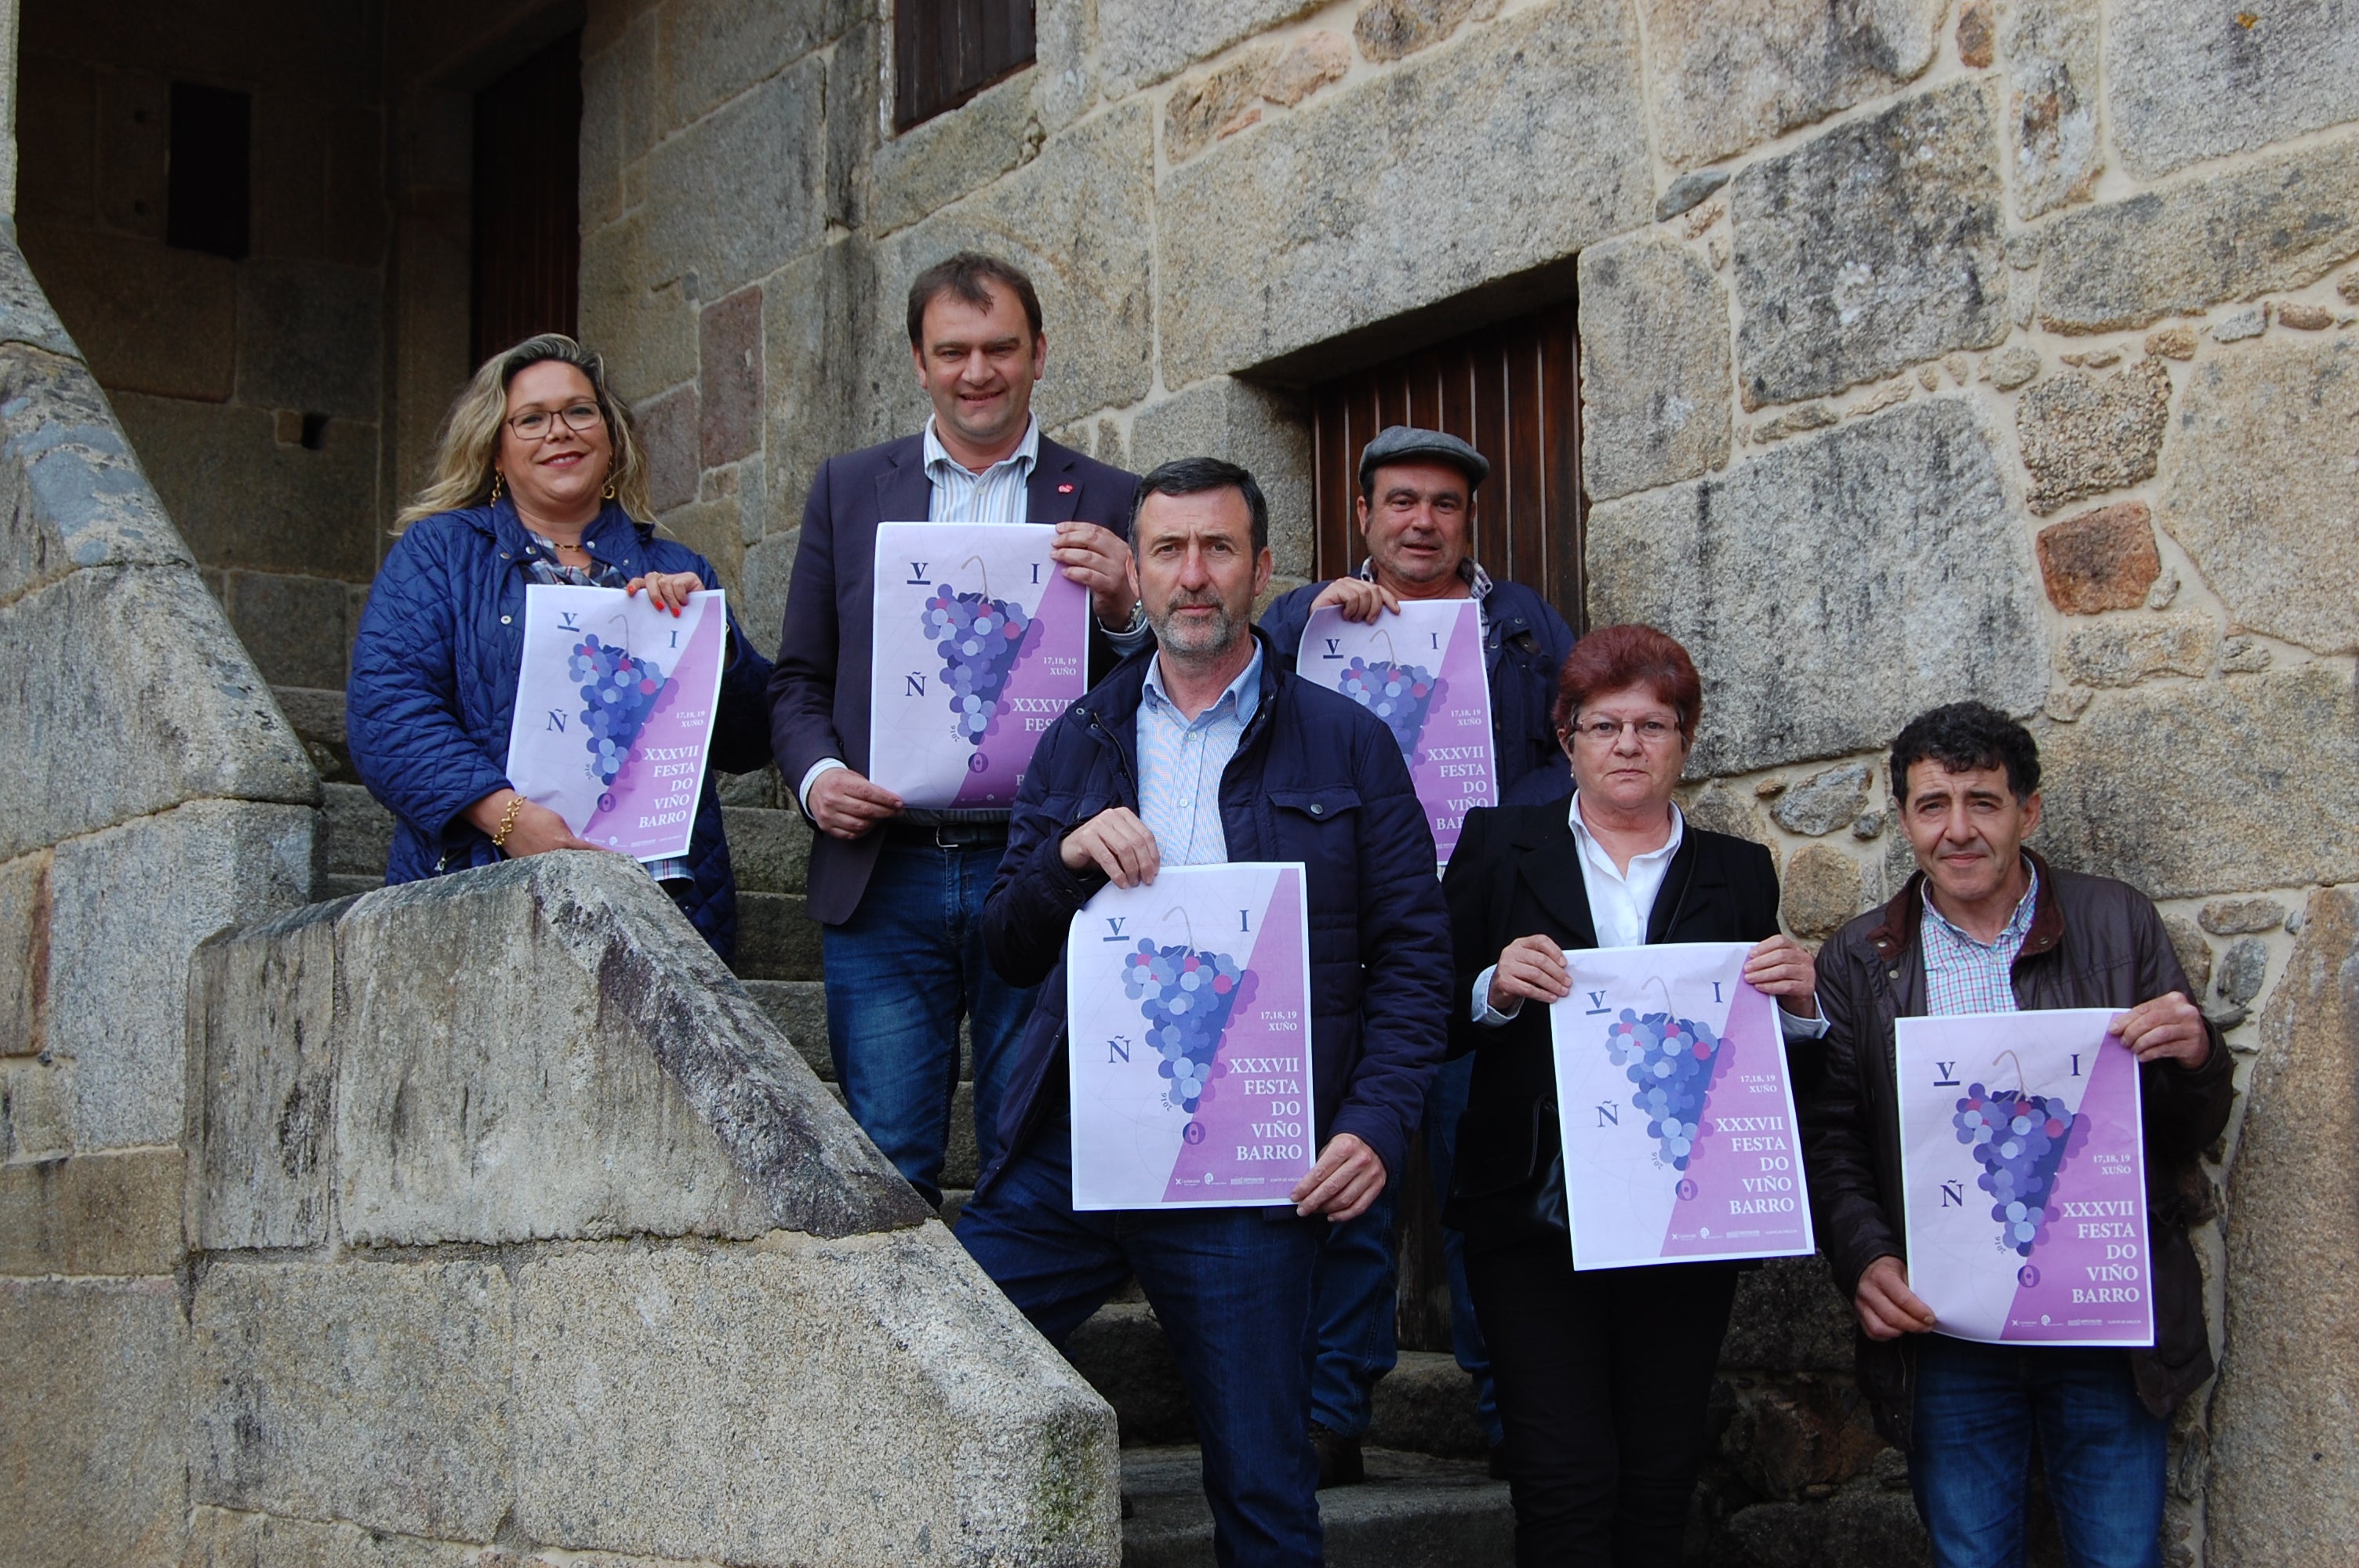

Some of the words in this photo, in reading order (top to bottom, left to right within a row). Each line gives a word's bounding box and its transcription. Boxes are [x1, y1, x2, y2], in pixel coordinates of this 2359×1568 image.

[911, 562, 929, 579] V
[1030, 563, 1040, 584] I
[561, 612, 578, 626] V
[668, 630, 678, 648] I
[1325, 639, 1341, 654] V
[1431, 633, 1438, 650] I
[906, 672, 926, 696] Ñ
[1013, 699, 1074, 712] XXXVI
[547, 709, 567, 732] Ñ
[1458, 717, 1481, 726] XUÑO
[645, 746, 699, 760] XXXVII
[1428, 746, 1484, 760] XXXVII
[654, 762, 695, 777] FESTA
[1440, 764, 1485, 778] FESTA
[671, 778, 692, 791] DO
[1463, 781, 1487, 793] DO
[655, 794, 689, 809] VIÑO
[639, 812, 686, 828] BARRO
[1107, 917, 1126, 935] V
[1240, 910, 1249, 931] I
[1587, 990, 1607, 1008] V
[1712, 982, 1723, 1004] I
[1269, 1022, 1296, 1031] XUÑO
[1107, 1036, 1131, 1063] Ñ
[1230, 1058, 1299, 1073] XXXVII
[1936, 1062, 1956, 1080] V
[2070, 1054, 2081, 1076] I
[1245, 1080, 1299, 1094] FESTA
[1272, 1101, 1300, 1116] DO
[1596, 1101, 1618, 1127] Ñ
[1252, 1120, 1301, 1138] VIÑO
[1716, 1116, 1783, 1131] XXXVII
[1732, 1137, 1787, 1151] FESTA
[1237, 1145, 1302, 1160] BARRO
[1760, 1156, 1789, 1171] DO
[2102, 1165, 2131, 1174] XUÑO
[1743, 1175, 1791, 1192] VIÑO
[1940, 1180, 1963, 1207] Ñ
[1730, 1198, 1794, 1214] BARRO
[2063, 1201, 2133, 1217] XXXVII
[2078, 1223, 2135, 1238] FESTA
[2106, 1244, 2136, 1259] DO
[2086, 1264, 2138, 1281] VIÑO
[2072, 1287, 2139, 1303] BARRO
